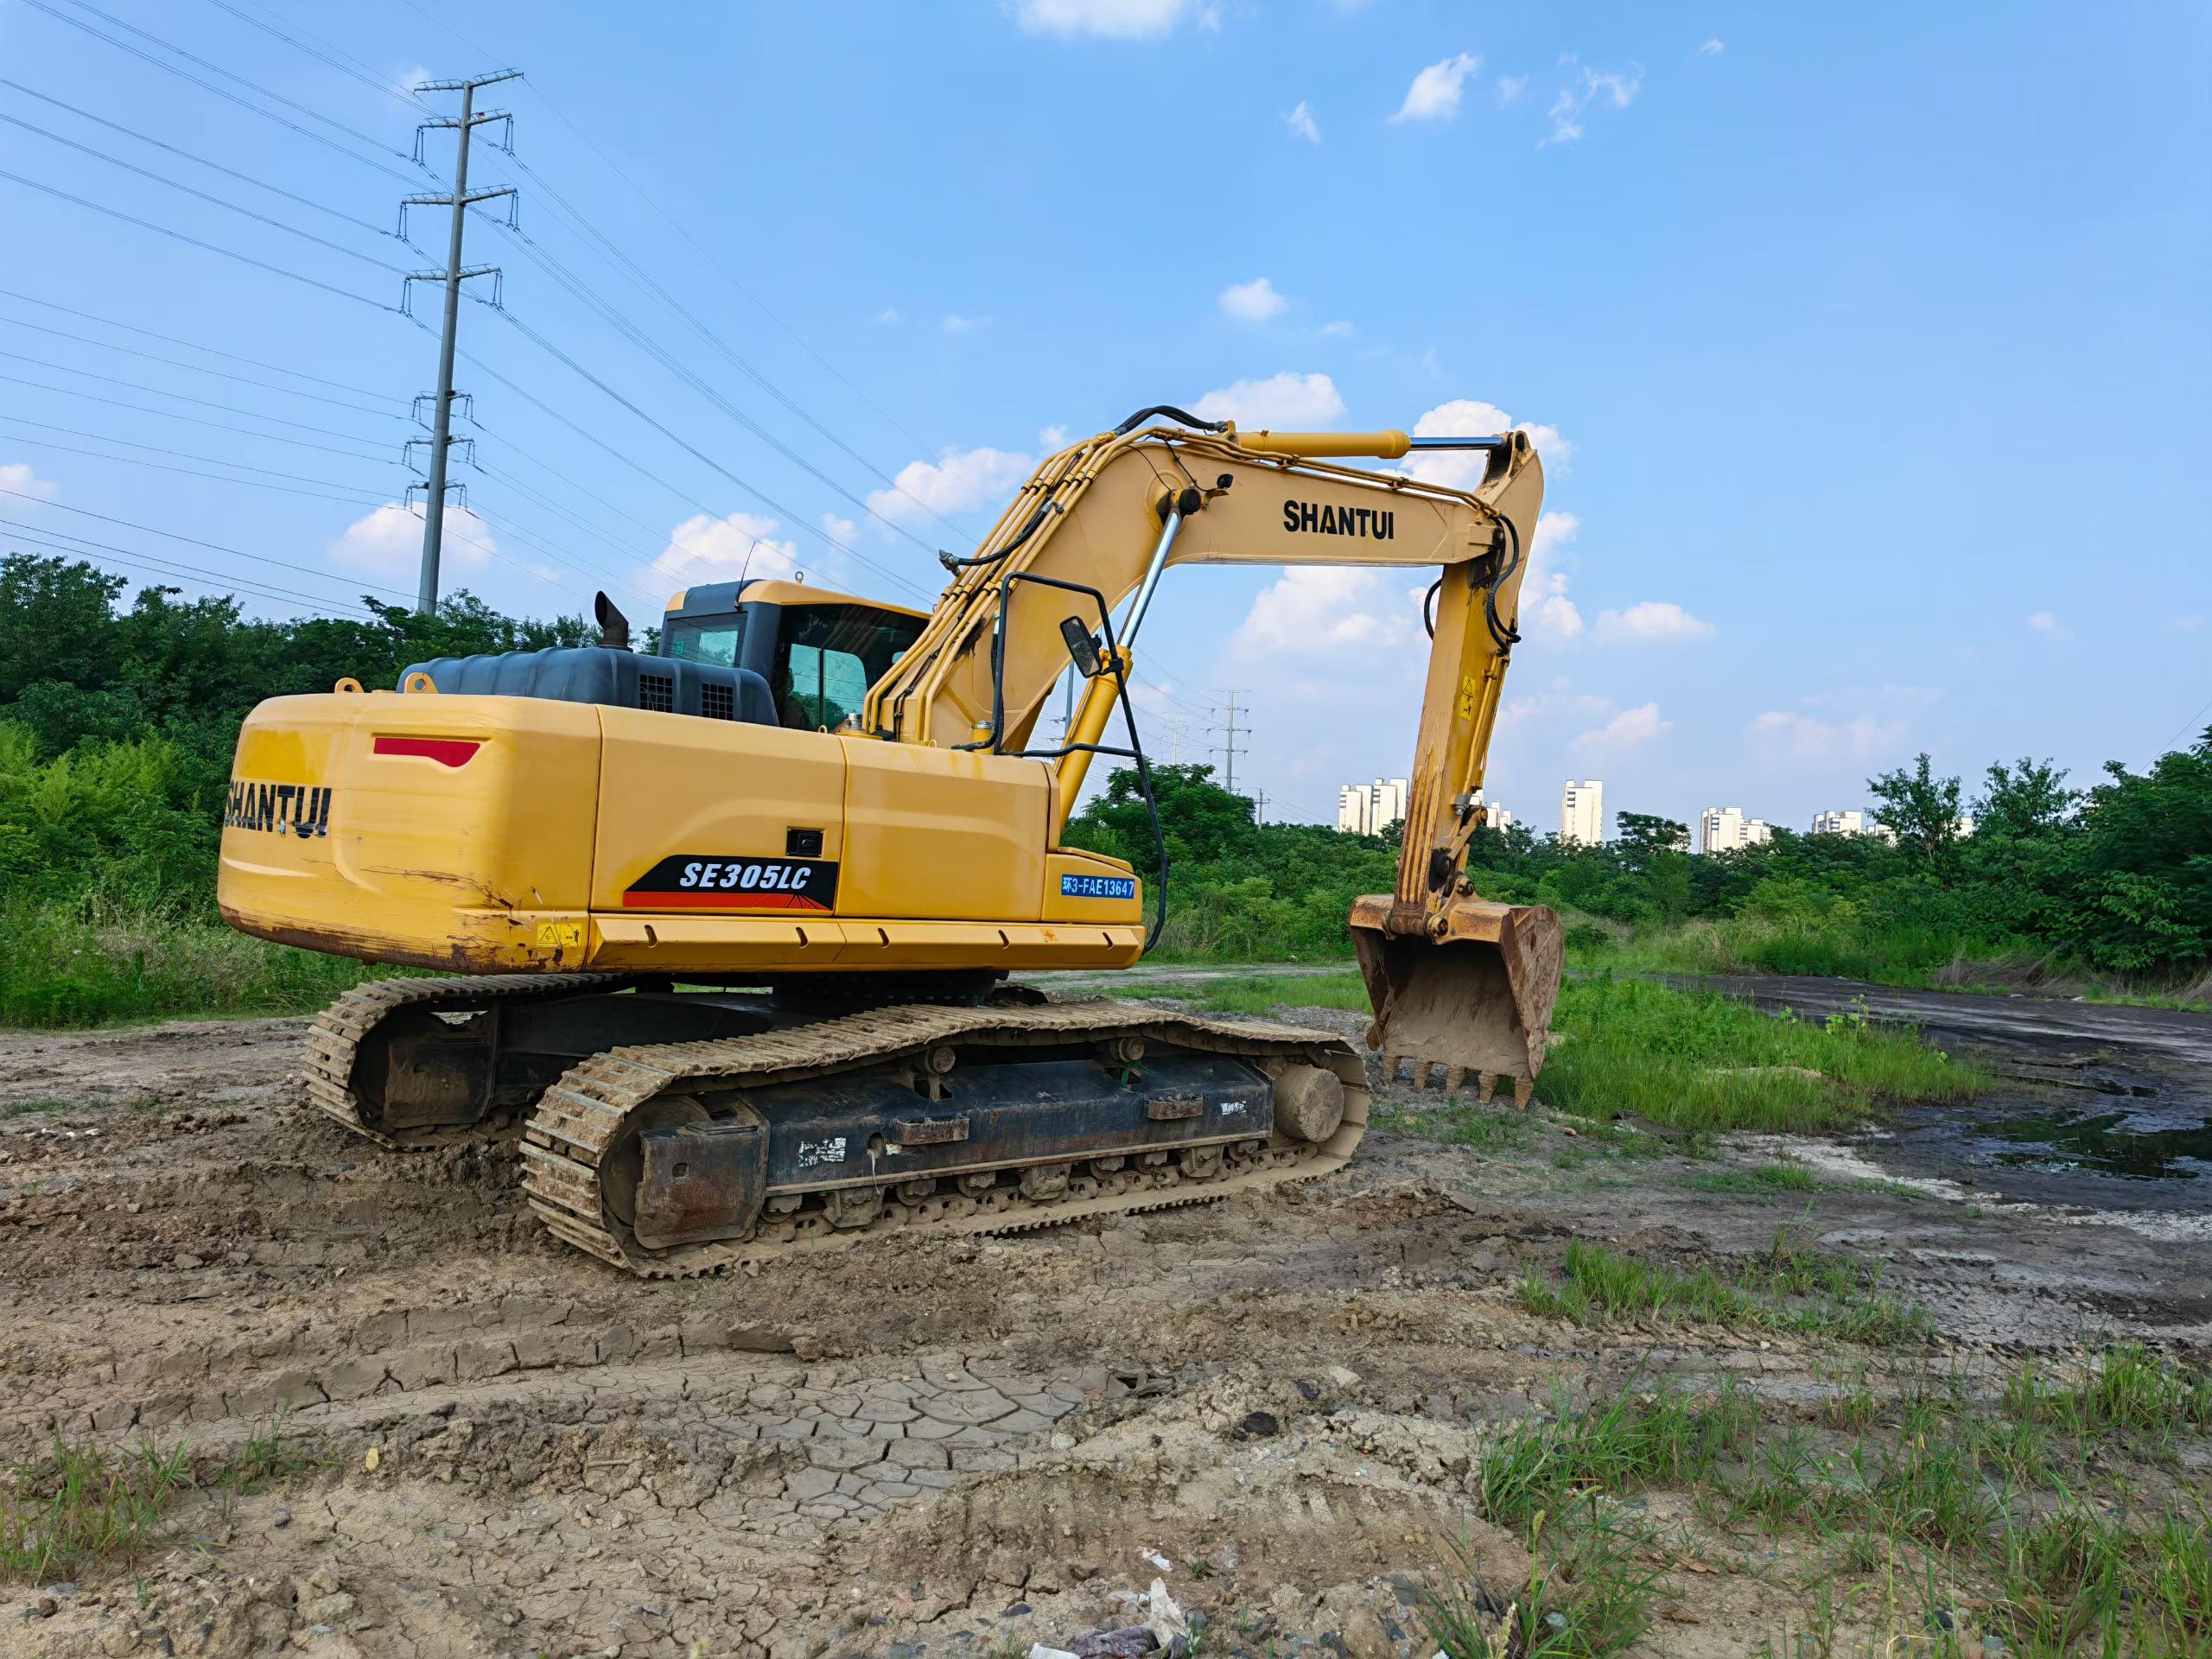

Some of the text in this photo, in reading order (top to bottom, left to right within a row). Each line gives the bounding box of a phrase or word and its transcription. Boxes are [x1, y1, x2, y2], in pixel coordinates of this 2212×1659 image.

[1283, 499, 1394, 540] SHANTUI
[225, 779, 332, 839] SHANTUI
[679, 862, 811, 890] SE305LC
